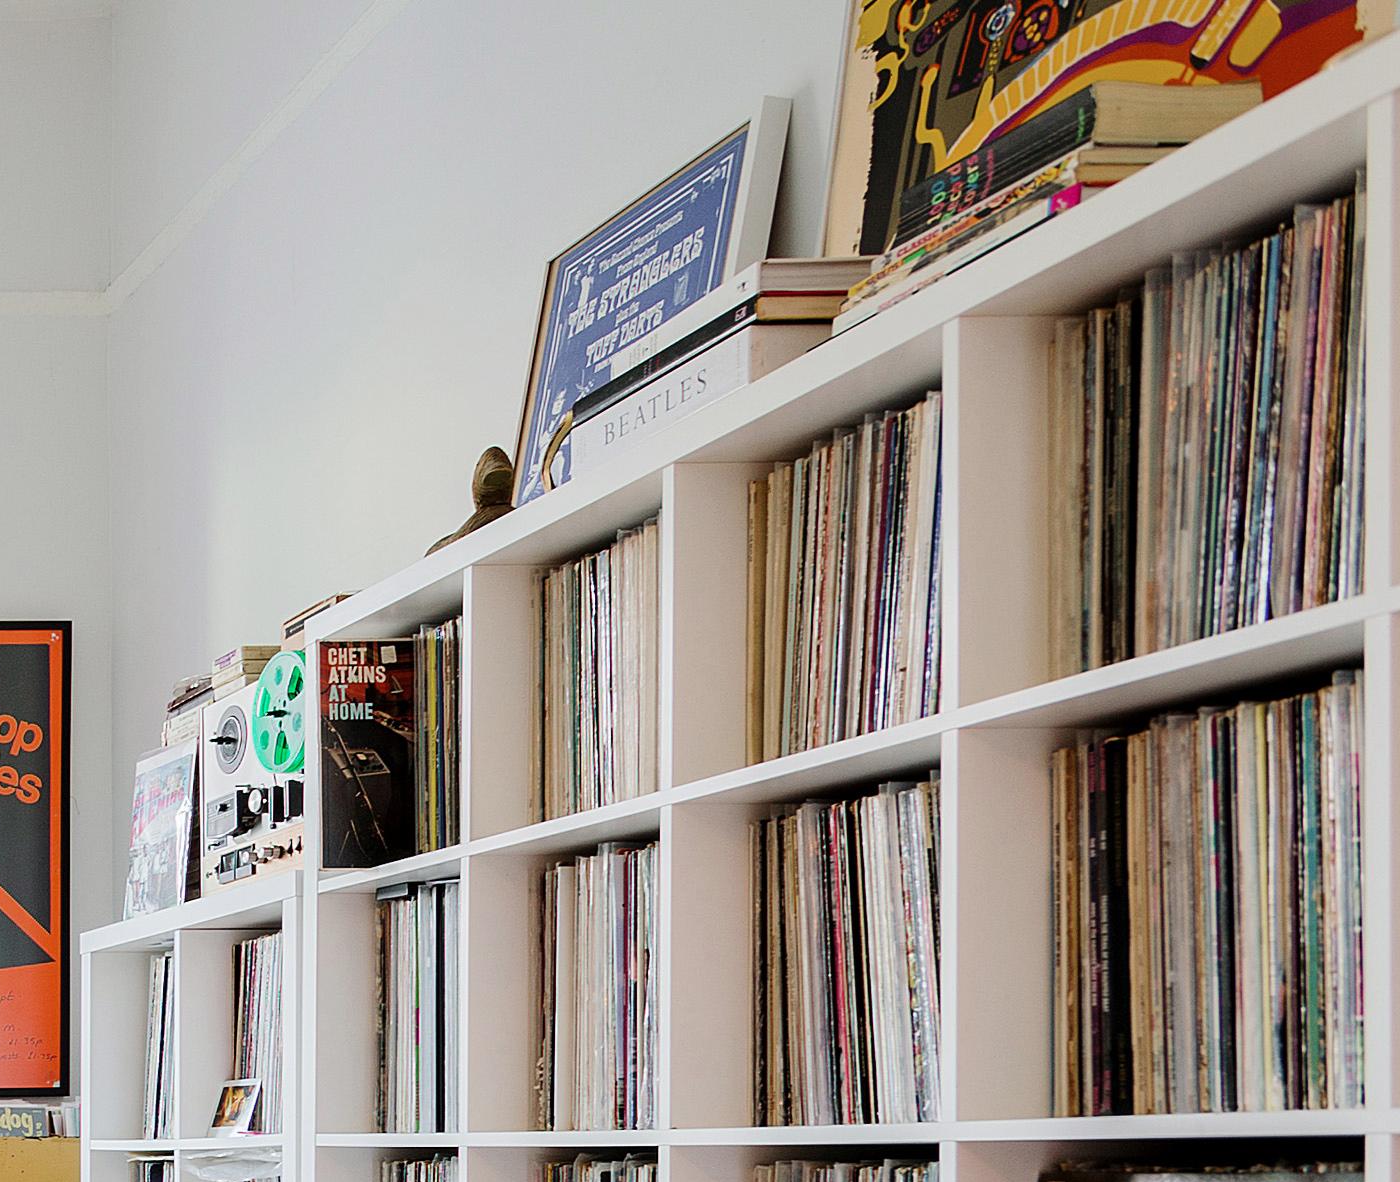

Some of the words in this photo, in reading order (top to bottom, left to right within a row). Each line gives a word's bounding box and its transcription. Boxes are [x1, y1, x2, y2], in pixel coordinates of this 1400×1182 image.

[567, 297, 598, 339] THE
[597, 226, 705, 320] STRANGLERS
[604, 368, 708, 445] BEATLES
[328, 648, 367, 665] CHET
[328, 666, 386, 683] ATKINS
[329, 685, 348, 702] AT
[329, 703, 374, 720] HOME
